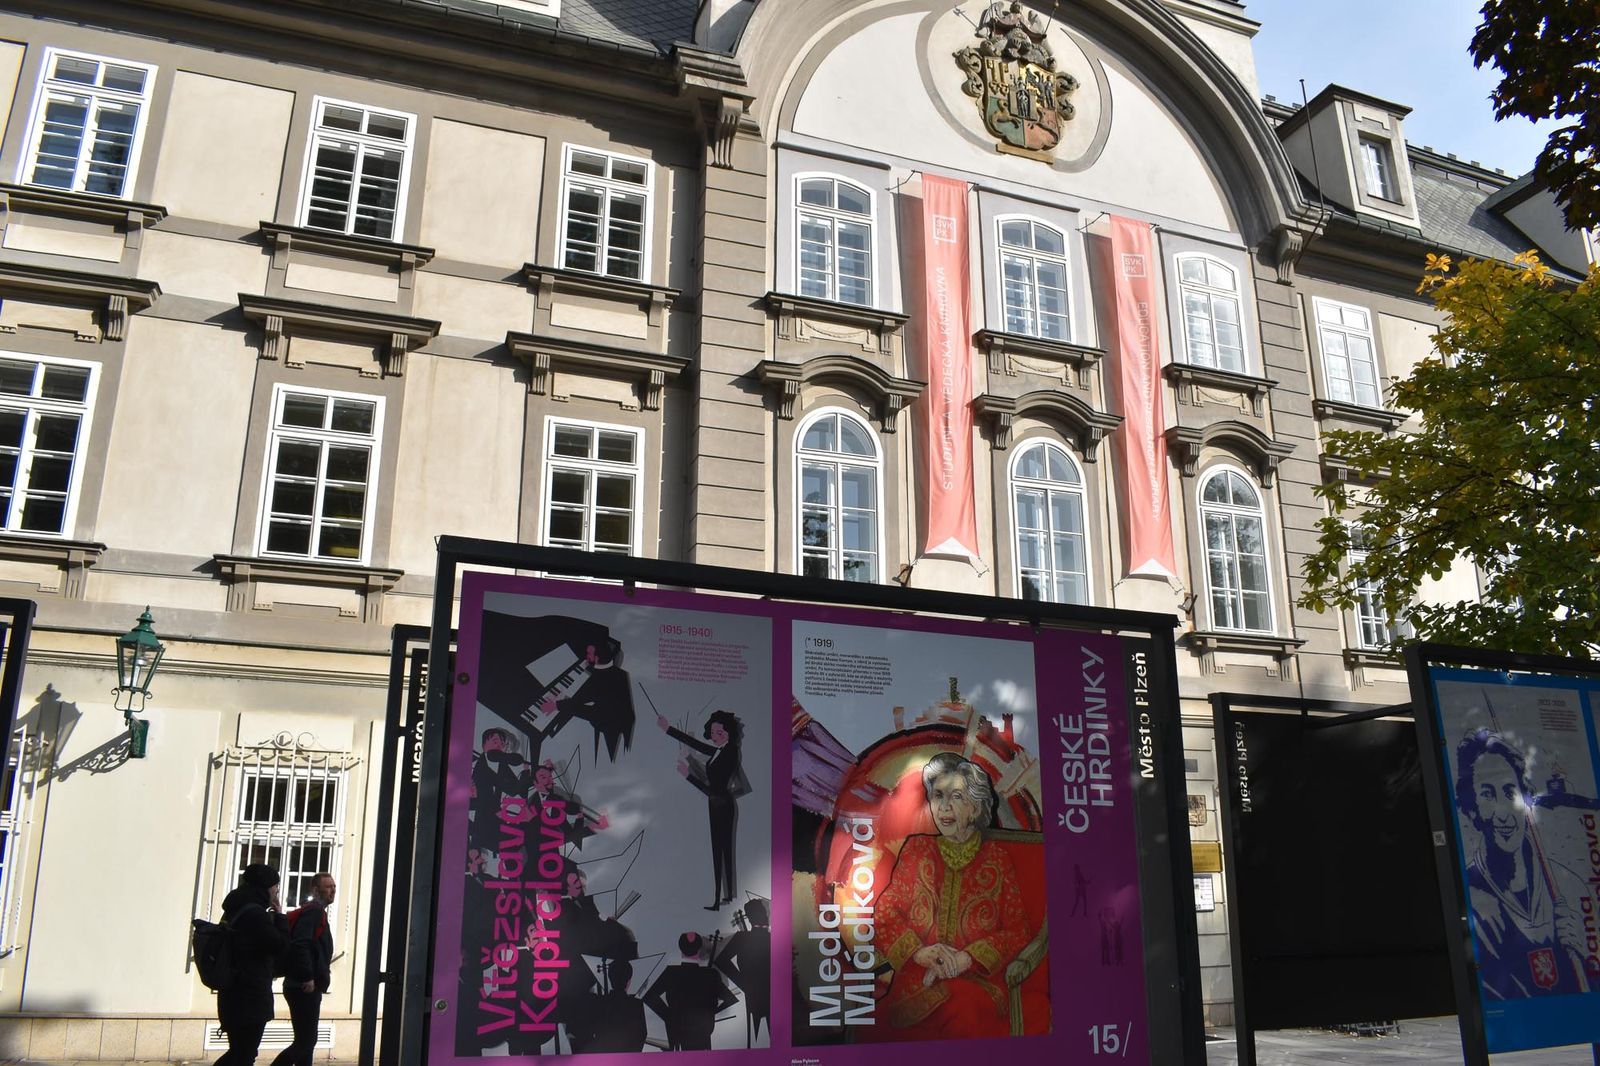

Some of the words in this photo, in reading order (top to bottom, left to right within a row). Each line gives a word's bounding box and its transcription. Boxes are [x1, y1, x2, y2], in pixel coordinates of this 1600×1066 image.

[936, 266, 951, 336] KNIHOVNA
[1137, 302, 1152, 370] EDUCATION
[938, 340, 954, 404] VĚDECKÁ
[1141, 370, 1152, 400] AND
[1132, 652, 1149, 706] Plzeň
[1081, 646, 1114, 807] HRDINKY
[1138, 713, 1155, 779] Město
[1052, 713, 1090, 833] ČESKÉ
[477, 796, 526, 1035] Vítězslava
[842, 817, 876, 1025] Mládková
[808, 904, 841, 1026] Meda
